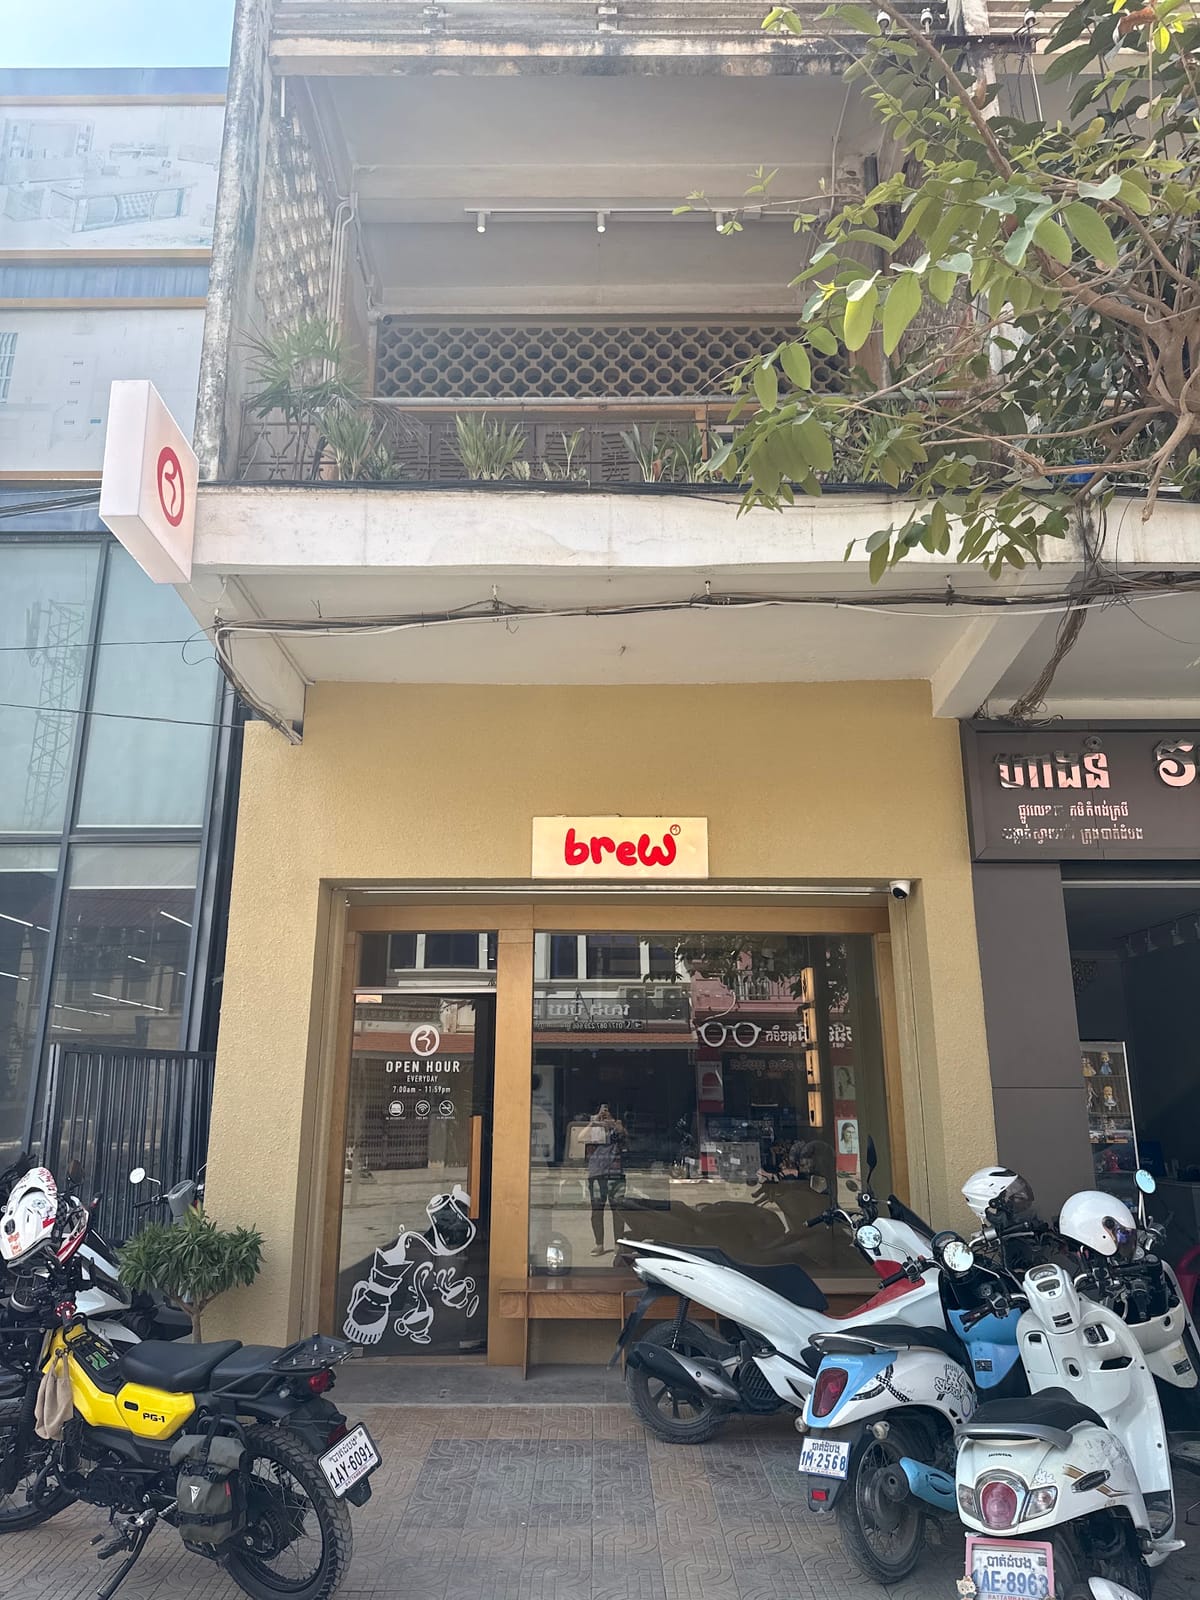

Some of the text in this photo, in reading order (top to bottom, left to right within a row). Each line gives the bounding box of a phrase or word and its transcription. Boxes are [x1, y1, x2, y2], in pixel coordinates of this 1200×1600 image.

[564, 827, 677, 866] brew
[385, 1060, 460, 1073] OPEN HOUR
[406, 1074, 438, 1083] EVERYDAY
[392, 1085, 416, 1094] 7:00am
[424, 1085, 451, 1095] 11:59pm
[143, 1412, 165, 1423] PG-1
[329, 1442, 374, 1489] 1AY-6091
